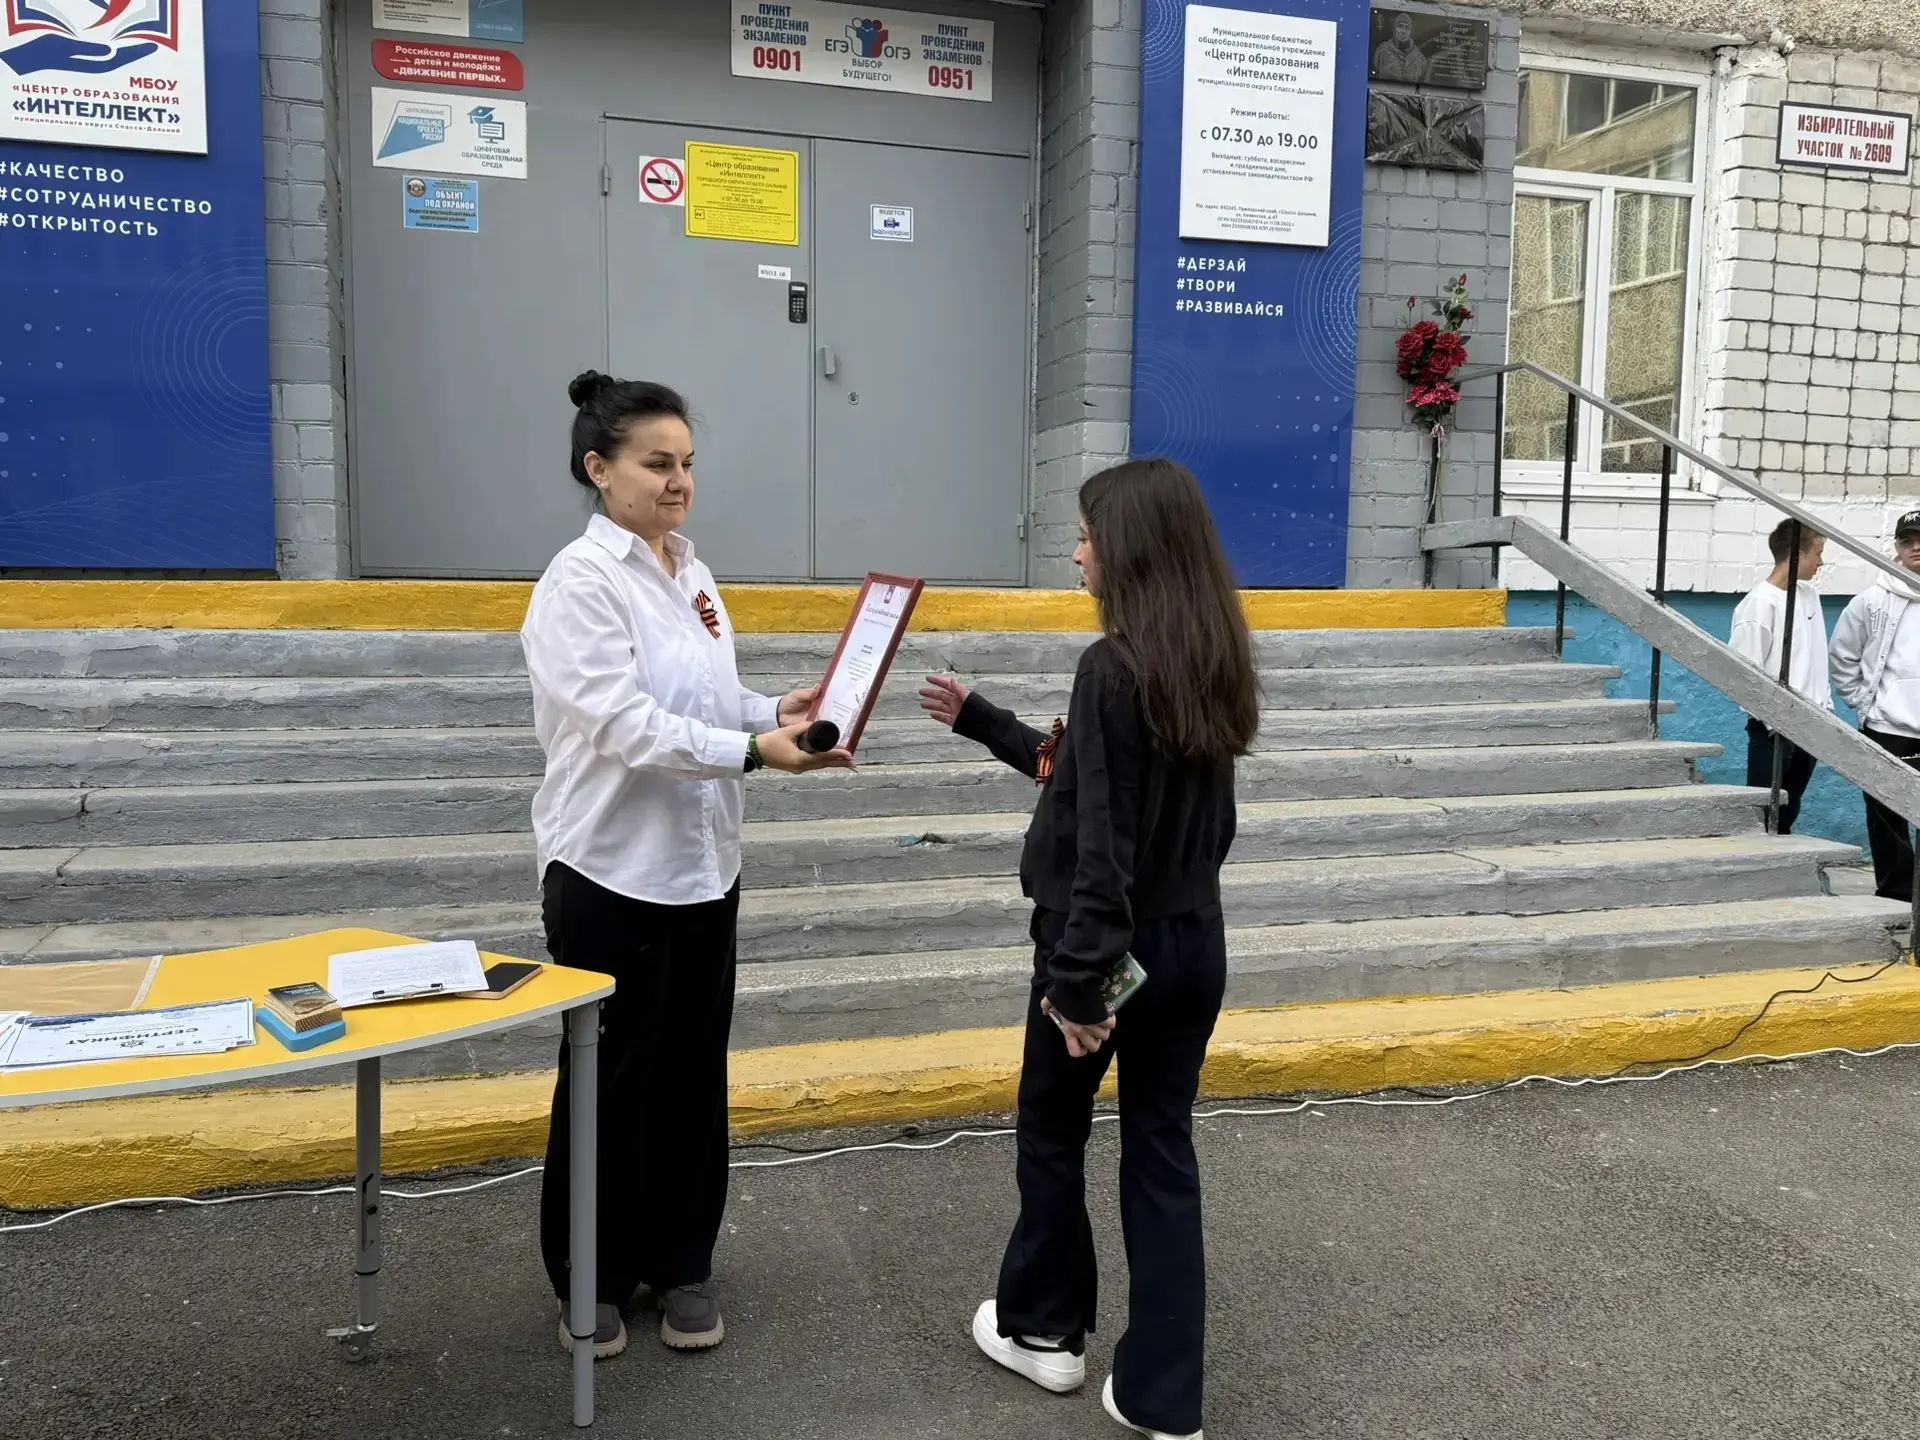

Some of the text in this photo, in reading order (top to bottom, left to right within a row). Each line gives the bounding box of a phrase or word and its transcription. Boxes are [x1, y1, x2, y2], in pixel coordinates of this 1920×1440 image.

[758, 3, 791, 17] ПУНКТ
[740, 15, 809, 32] ПРОВЕДЕНИЯ
[938, 23, 968, 38] ПУНКТ
[743, 29, 807, 46] ЭКЗАМЕНОВ
[921, 34, 985, 53] ПРОВЕДЕНИЯ
[1212, 27, 1313, 46] Муниципальное бюджетное
[395, 45, 501, 62] Российское движение
[825, 38, 911, 60] ЕГЭ ОГЭ
[1198, 36, 1326, 57] общеобразовательное учреждение
[414, 58, 441, 67] детей
[452, 61, 501, 71] молодёжи
[753, 46, 801, 72] 0901
[852, 58, 883, 69] ВЫБОР
[923, 48, 982, 66] ЭКЗАМЕНОВ
[1204, 48, 1319, 70] «Центр образования
[393, 66, 507, 83] «ДВИЖЕНИЕ ПЕРВЫХ»
[842, 69, 892, 82] БУДУЩЕГО!
[928, 65, 973, 90] 0951
[1226, 66, 1297, 82] «Интеллект»
[129, 76, 178, 91] МБОУ
[1197, 77, 1325, 96] муниципального округа Спасск-Дальний
[13, 84, 180, 105] «ЦЕНТР ОБРАЗОВАНИЯ
[13, 97, 181, 124] «ИНТЕЛЛЕКТ»
[1230, 107, 1290, 121] Режим работы:
[1797, 114, 1895, 140] ИЗБИРАТЕЛЬНЫЙ
[1200, 126, 1318, 150] с 07.30 до 19.00
[461, 152, 523, 163] ОБРАЗОВАТЕЛЬНАЯ
[474, 145, 511, 154] ЦИФРОВАЯ
[1797, 139, 1892, 163] УЧАСТОК № 2609
[481, 160, 503, 169] СРЕДА
[733, 162, 780, 173] образования
[1211, 152, 1306, 166] Выходные: суббота, воскресенье
[0, 161, 125, 183] #КАЧЕСТВО
[0, 187, 212, 215] #СОТРУДНИЧЕСТВО
[435, 190, 464, 200] ОБЪЕКТ
[424, 199, 475, 210] ПОД ОХРАНОЙ
[0, 212, 158, 236] #ОТКРЫТОСТЬ
[1177, 256, 1246, 272] #ДЕРЗАЙ
[1176, 277, 1235, 293] #ТВОРИ
[1175, 299, 1283, 316] #РАЗВИВАЙСЯ
[66, 1028, 198, 1045] СЕРТИФИКАТ
